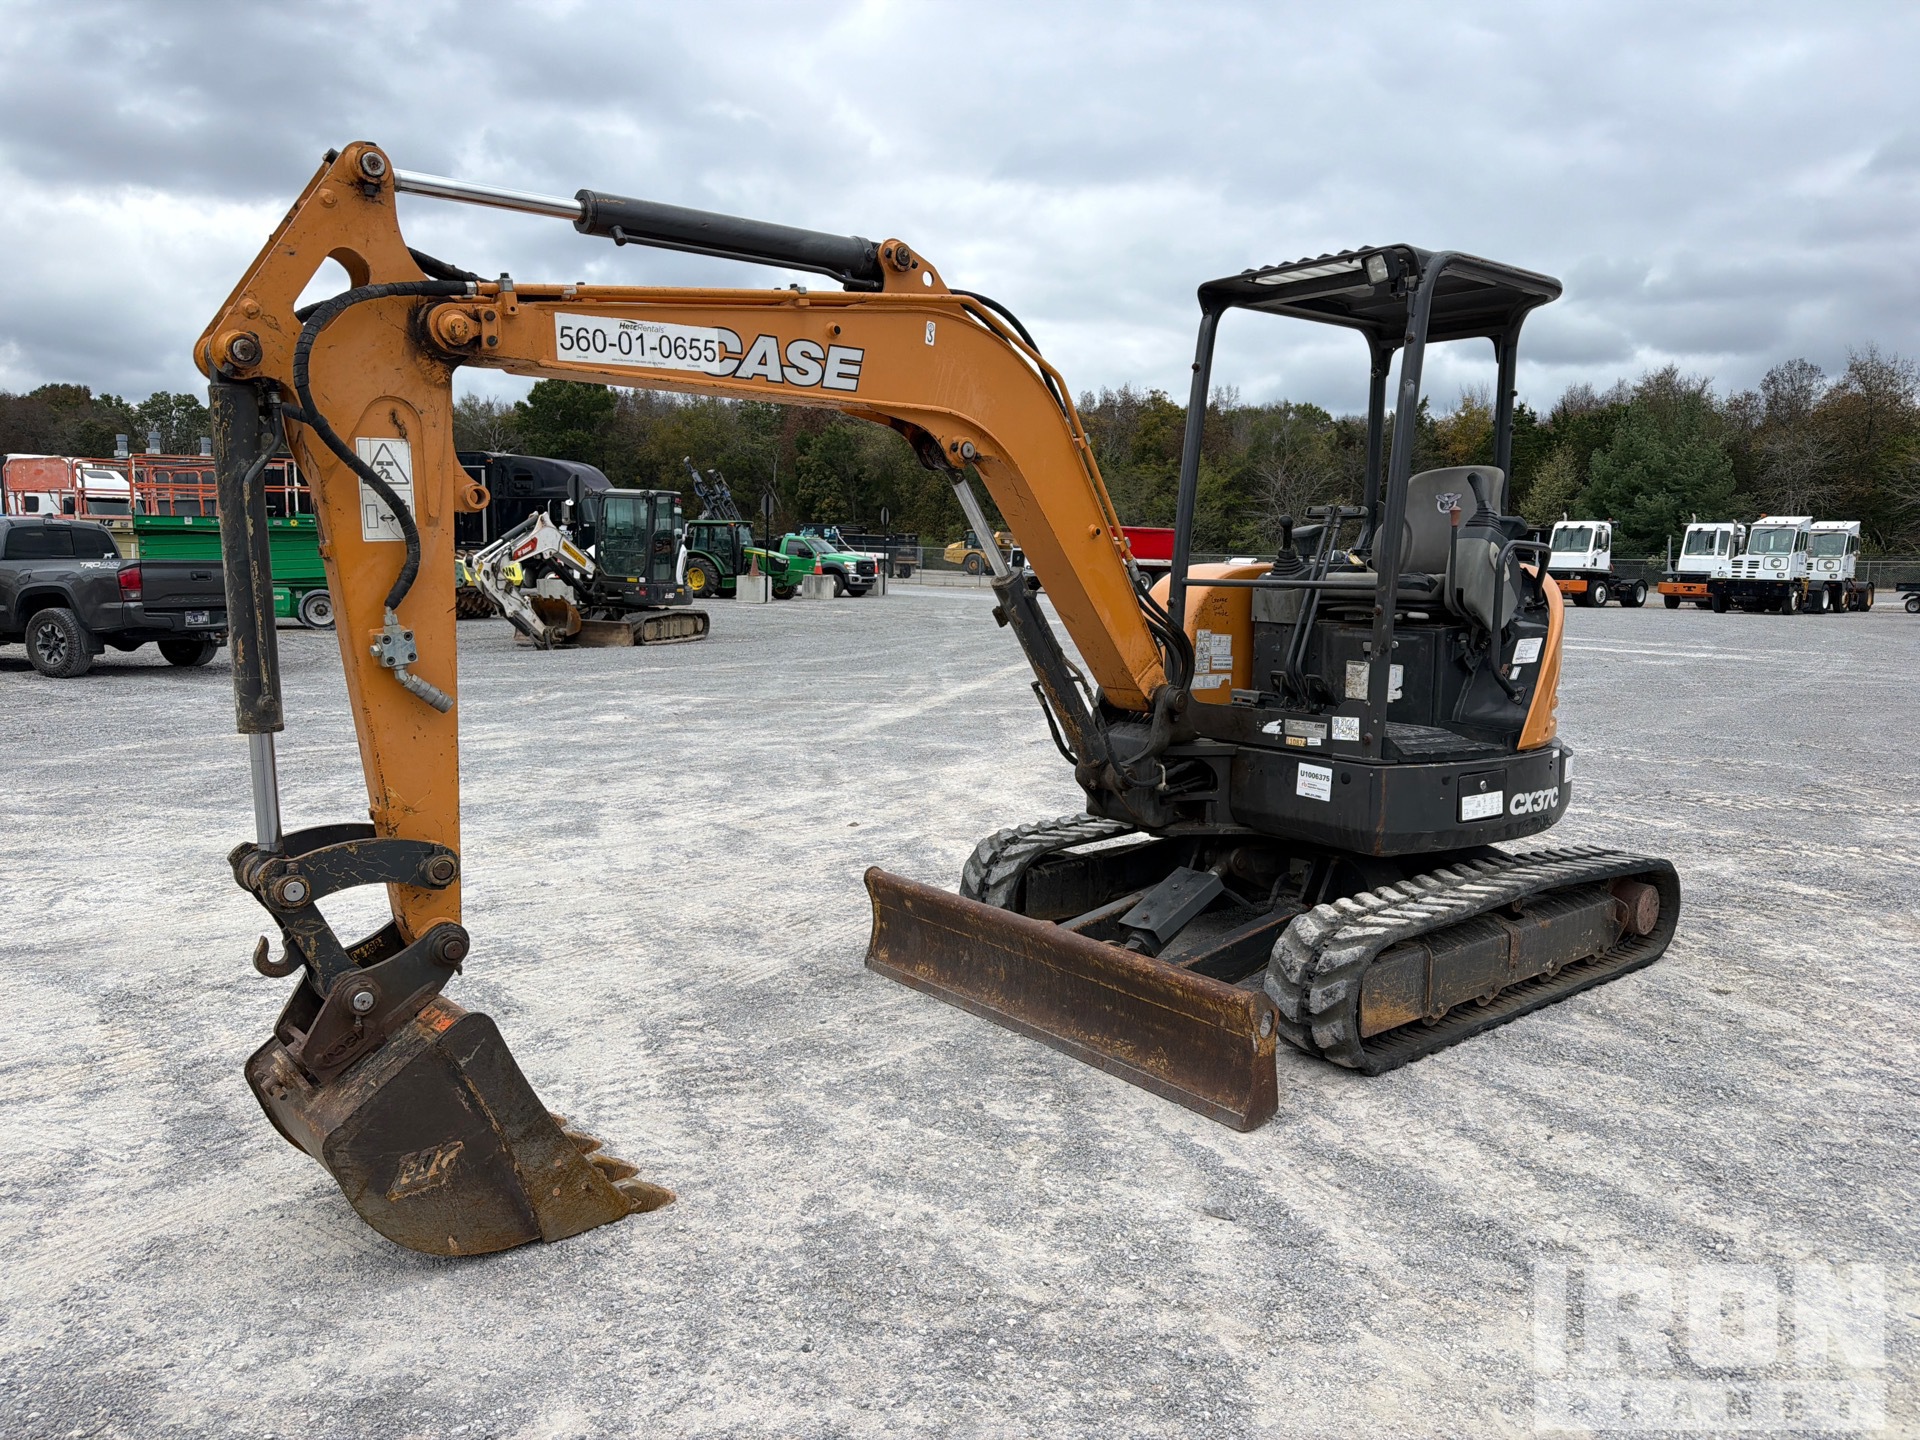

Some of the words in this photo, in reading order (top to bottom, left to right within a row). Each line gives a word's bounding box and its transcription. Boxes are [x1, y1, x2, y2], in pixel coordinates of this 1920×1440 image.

[559, 325, 717, 363] 560-01-0655
[1300, 769, 1330, 782] U1006375
[1509, 786, 1559, 816] CX37C
